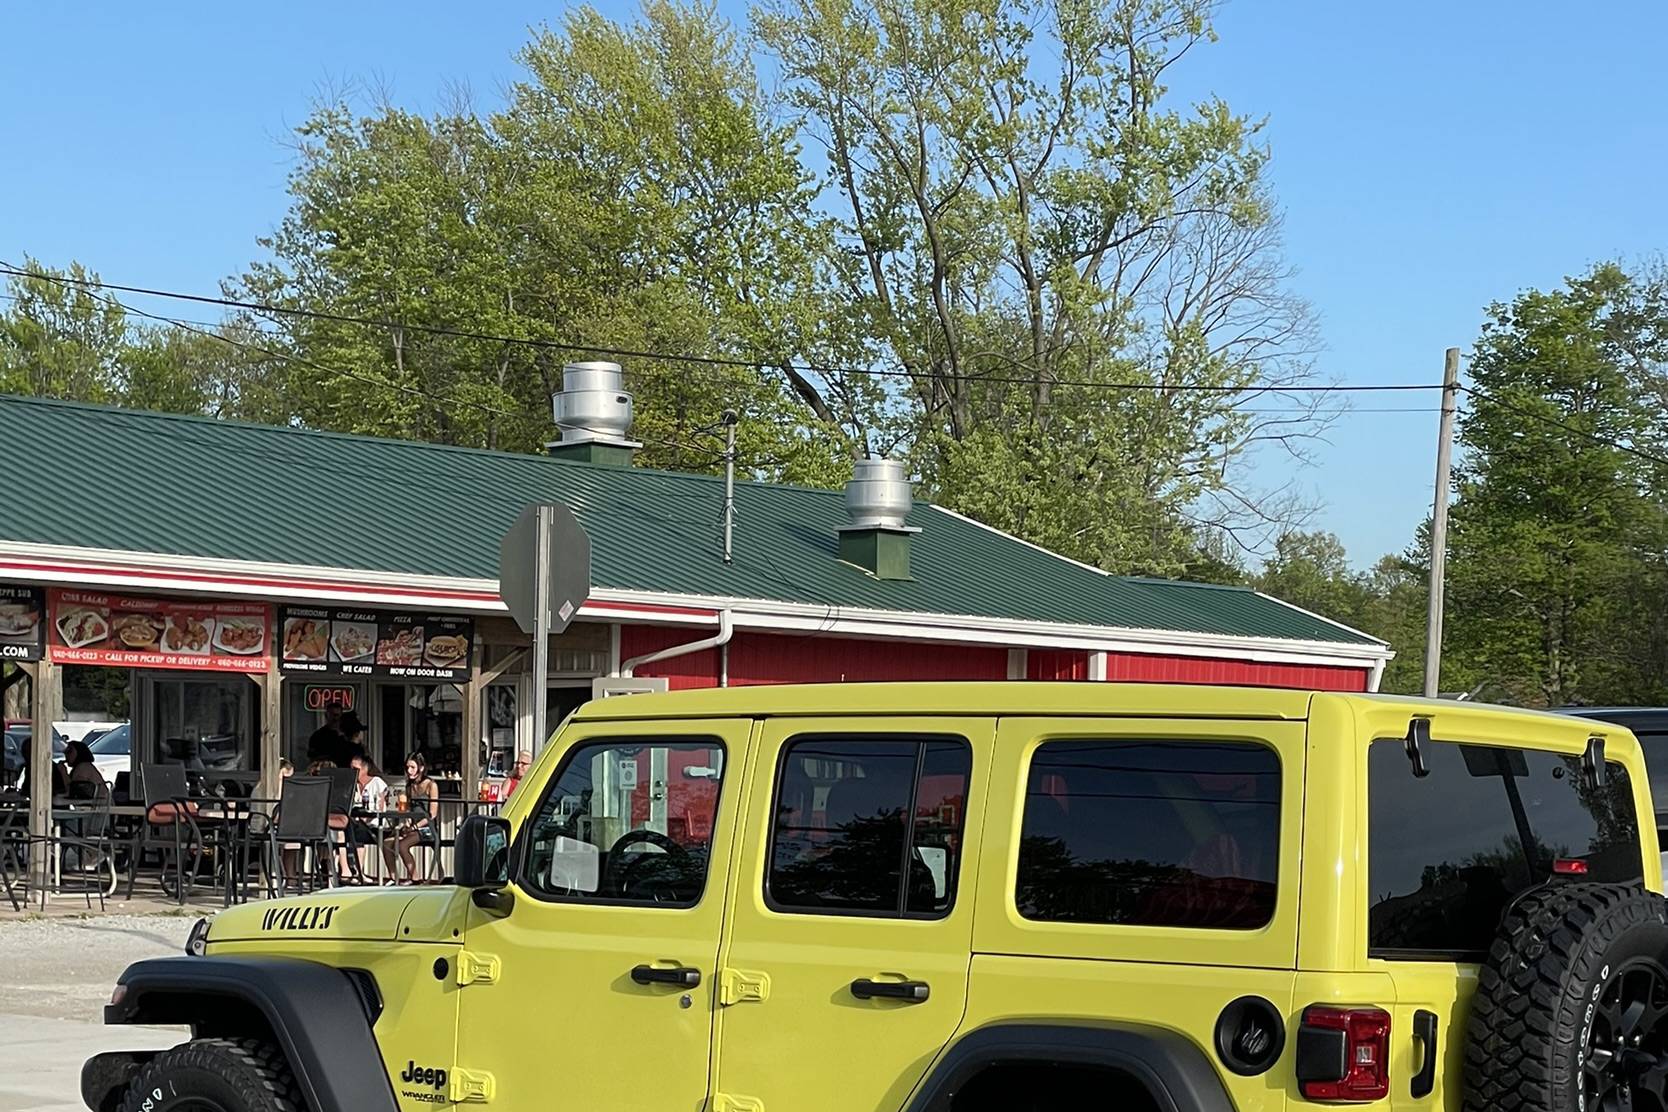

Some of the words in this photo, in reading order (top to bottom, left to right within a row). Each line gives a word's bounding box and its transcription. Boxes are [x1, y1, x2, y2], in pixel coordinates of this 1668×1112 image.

[82, 594, 108, 604] SALAD
[286, 607, 328, 618] MUSHROOMS
[336, 611, 353, 620] CHEF
[353, 613, 376, 622] SALAD
[393, 616, 412, 624] PIZZA
[105, 653, 123, 661] CALL
[124, 654, 138, 662] FOR
[140, 655, 165, 664] PICKUP
[166, 656, 176, 664] OR
[178, 656, 211, 666] DELIVERY
[342, 665, 353, 673] WE
[353, 665, 373, 674] CATER
[390, 667, 405, 675] NOW
[406, 668, 416, 676] ON
[417, 668, 435, 677] DOOR
[436, 669, 453, 678] DASH
[308, 688, 352, 708] OPEN
[262, 906, 340, 931] WILLYS
[401, 1060, 447, 1091] Jeep
[401, 1090, 446, 1102] WRANGLER
